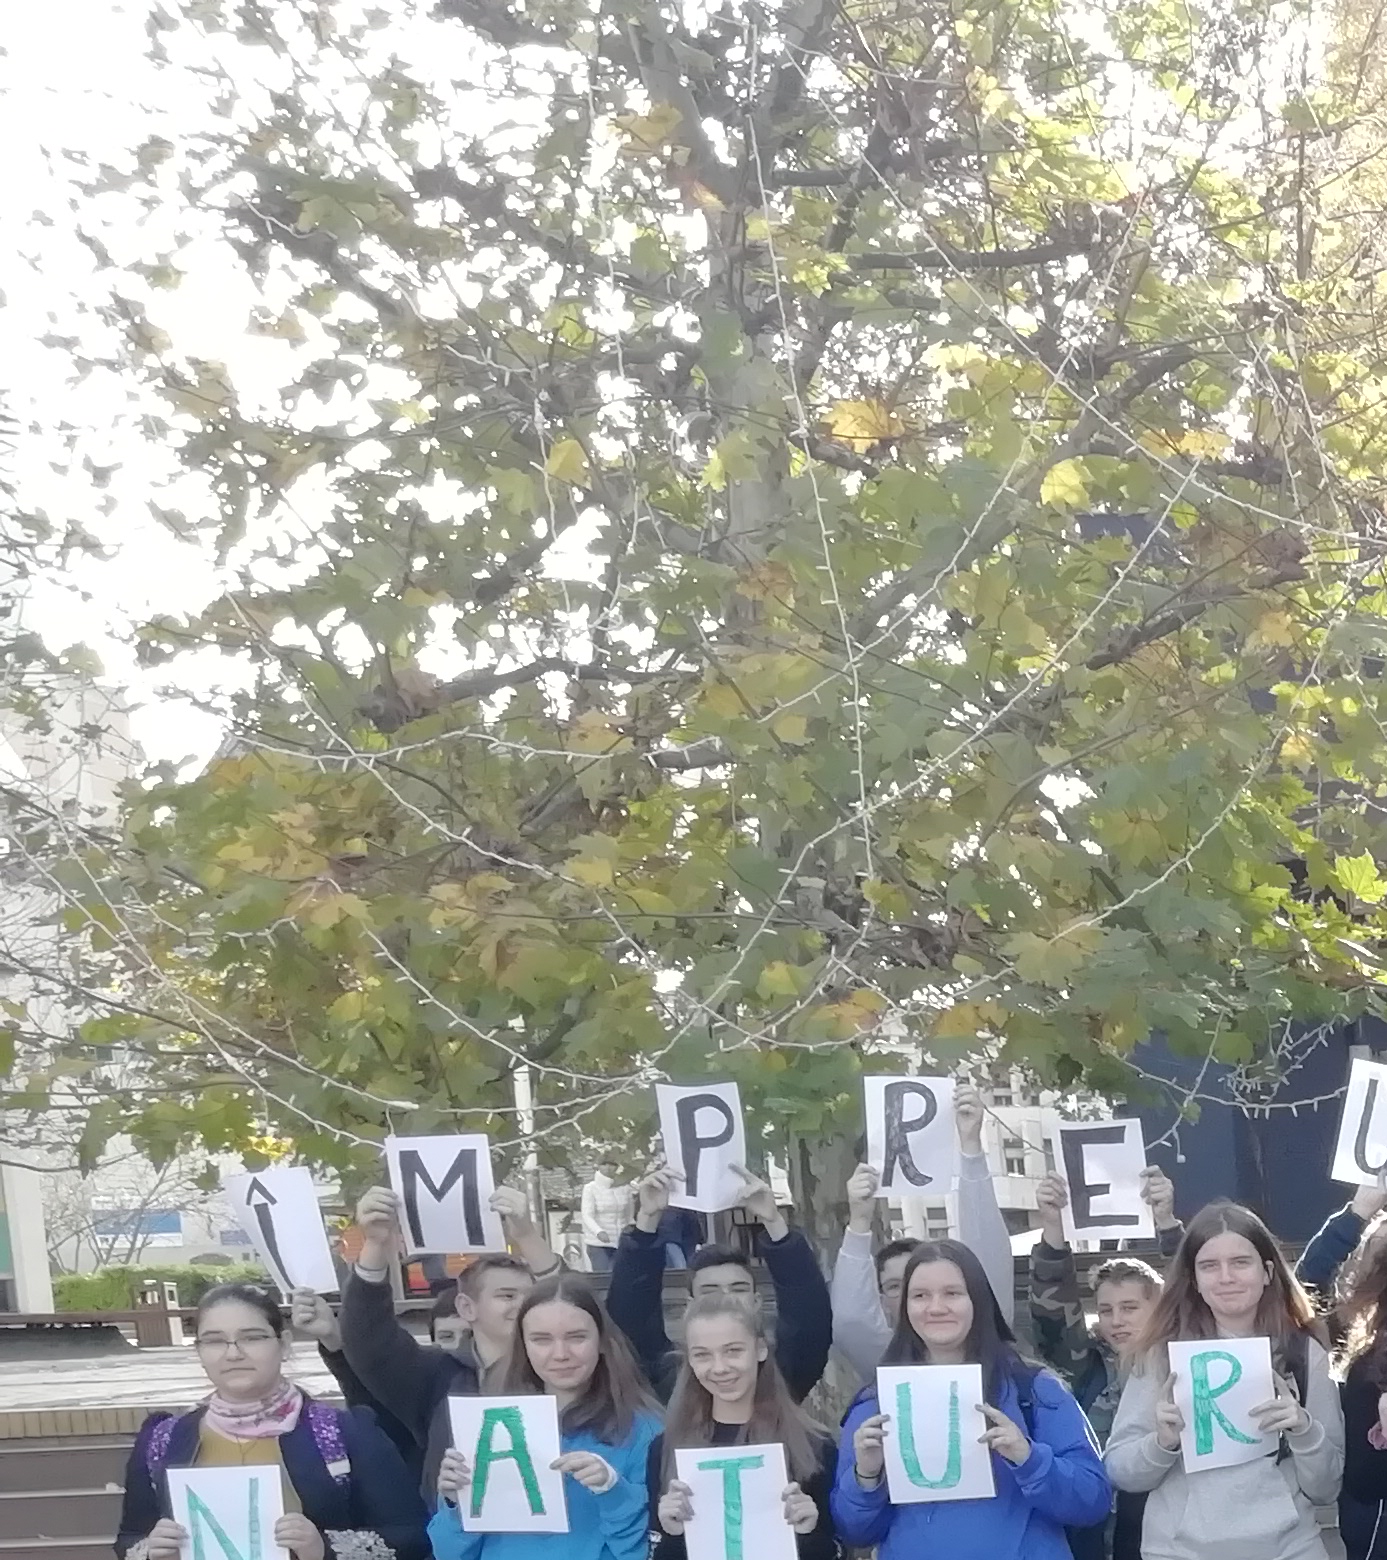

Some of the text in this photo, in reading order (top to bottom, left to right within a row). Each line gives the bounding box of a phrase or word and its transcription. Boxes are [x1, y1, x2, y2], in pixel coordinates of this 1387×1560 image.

[676, 1094, 735, 1197] P
[881, 1080, 938, 1188] R
[1059, 1126, 1140, 1230] E
[399, 1149, 487, 1249] M
[896, 1380, 962, 1490] U
[1189, 1351, 1264, 1456] R
[469, 1405, 547, 1519] A
